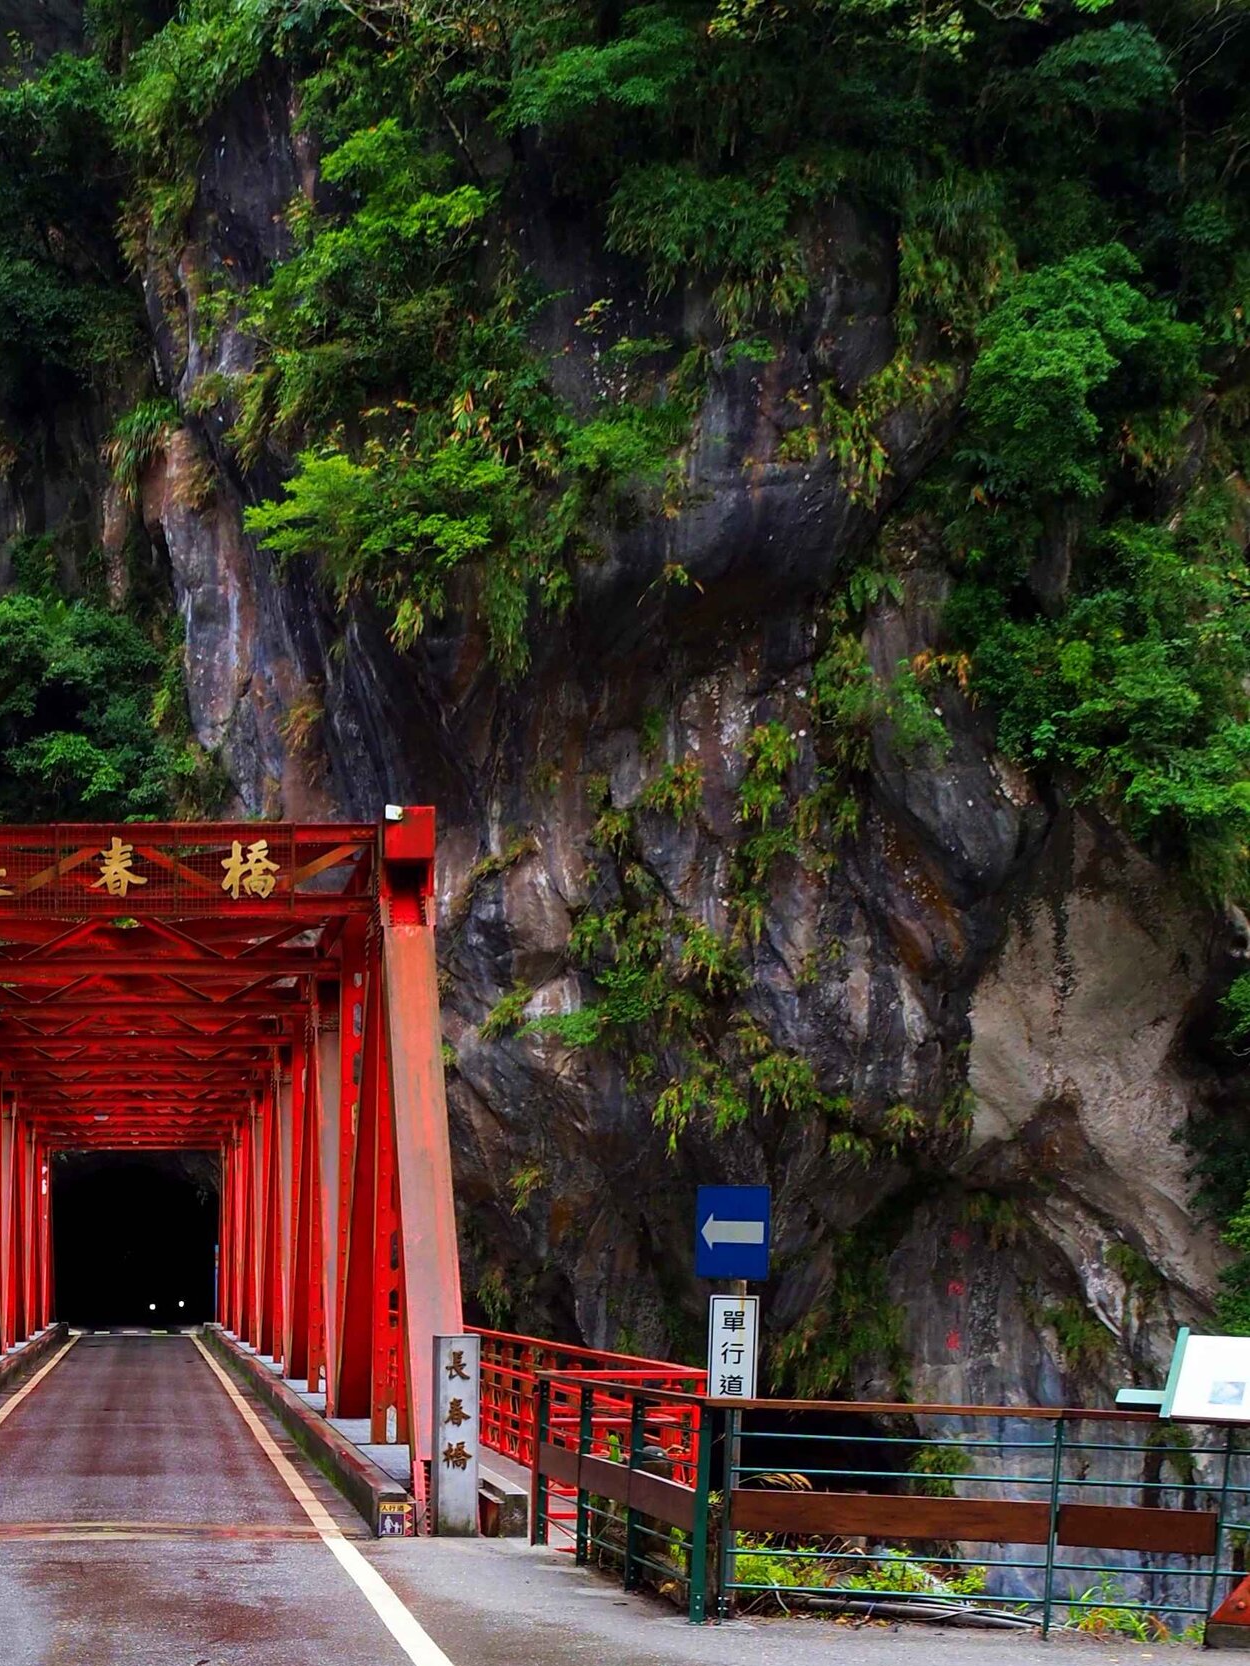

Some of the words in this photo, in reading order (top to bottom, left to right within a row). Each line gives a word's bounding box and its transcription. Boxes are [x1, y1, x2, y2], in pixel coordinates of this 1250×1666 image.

[719, 1310, 746, 1396] 單行道
[442, 1350, 472, 1471] 長春橋
